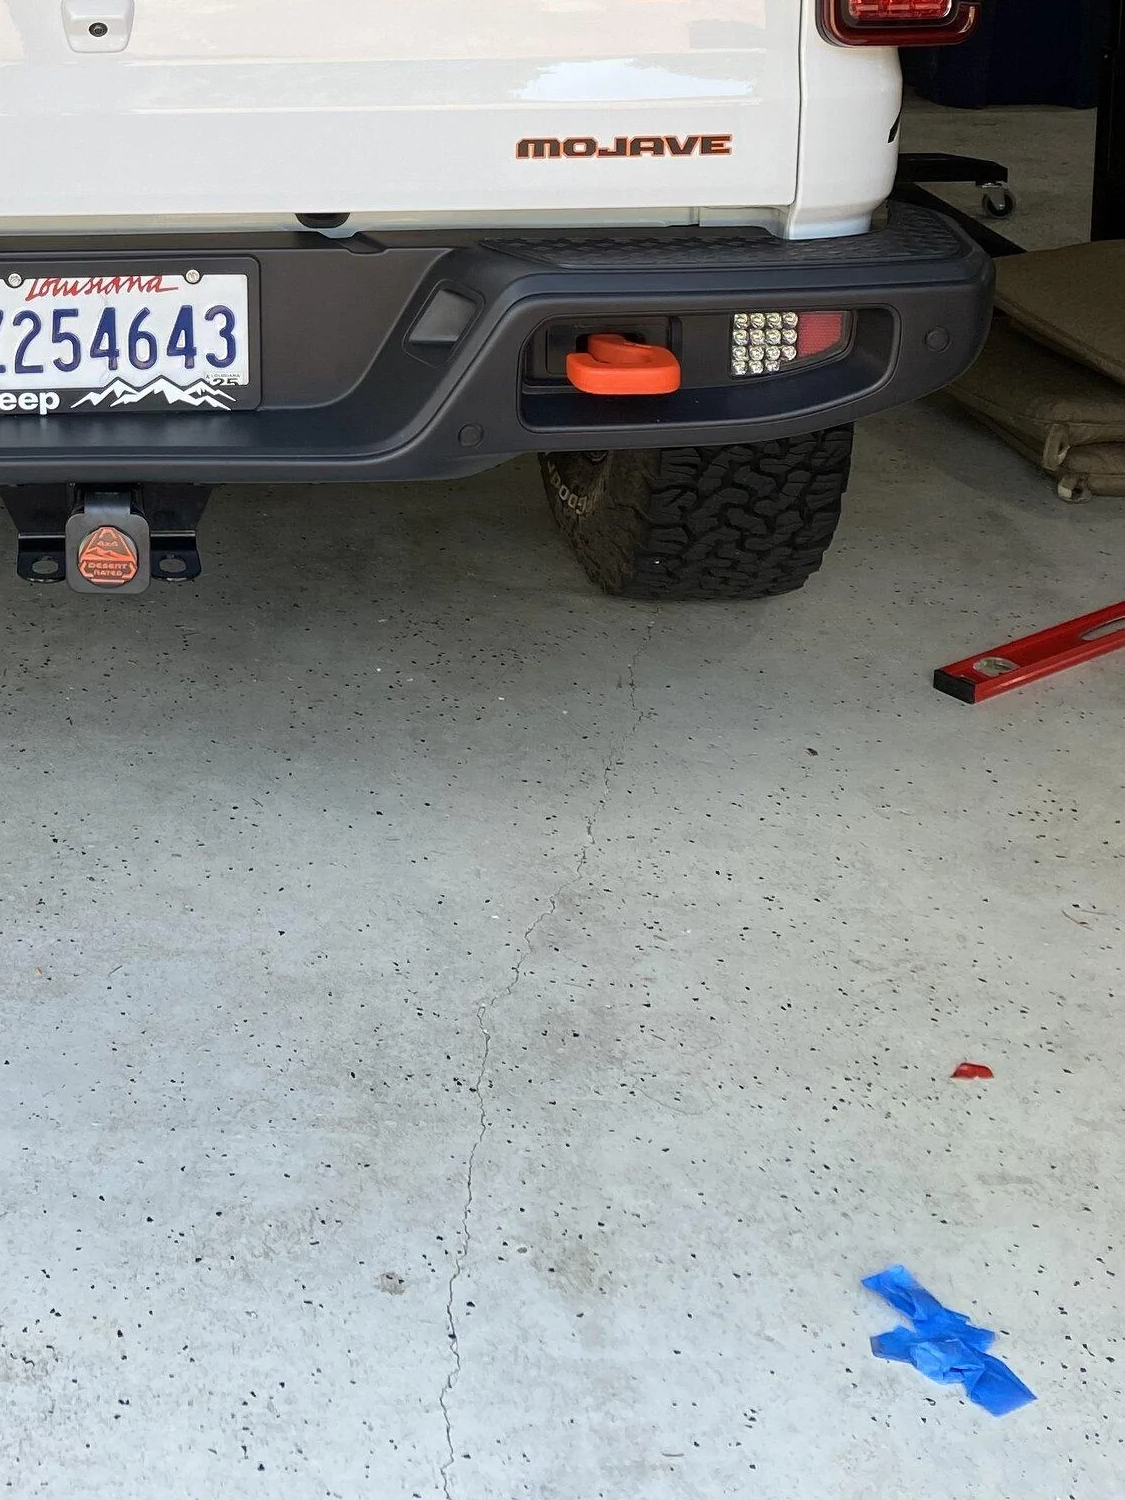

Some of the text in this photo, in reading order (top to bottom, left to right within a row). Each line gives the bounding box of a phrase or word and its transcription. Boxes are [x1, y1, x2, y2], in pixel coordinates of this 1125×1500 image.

[515, 133, 734, 161] MOJAVE
[24, 274, 179, 302] Louisiana
[87, 562, 128, 570] DESERT
